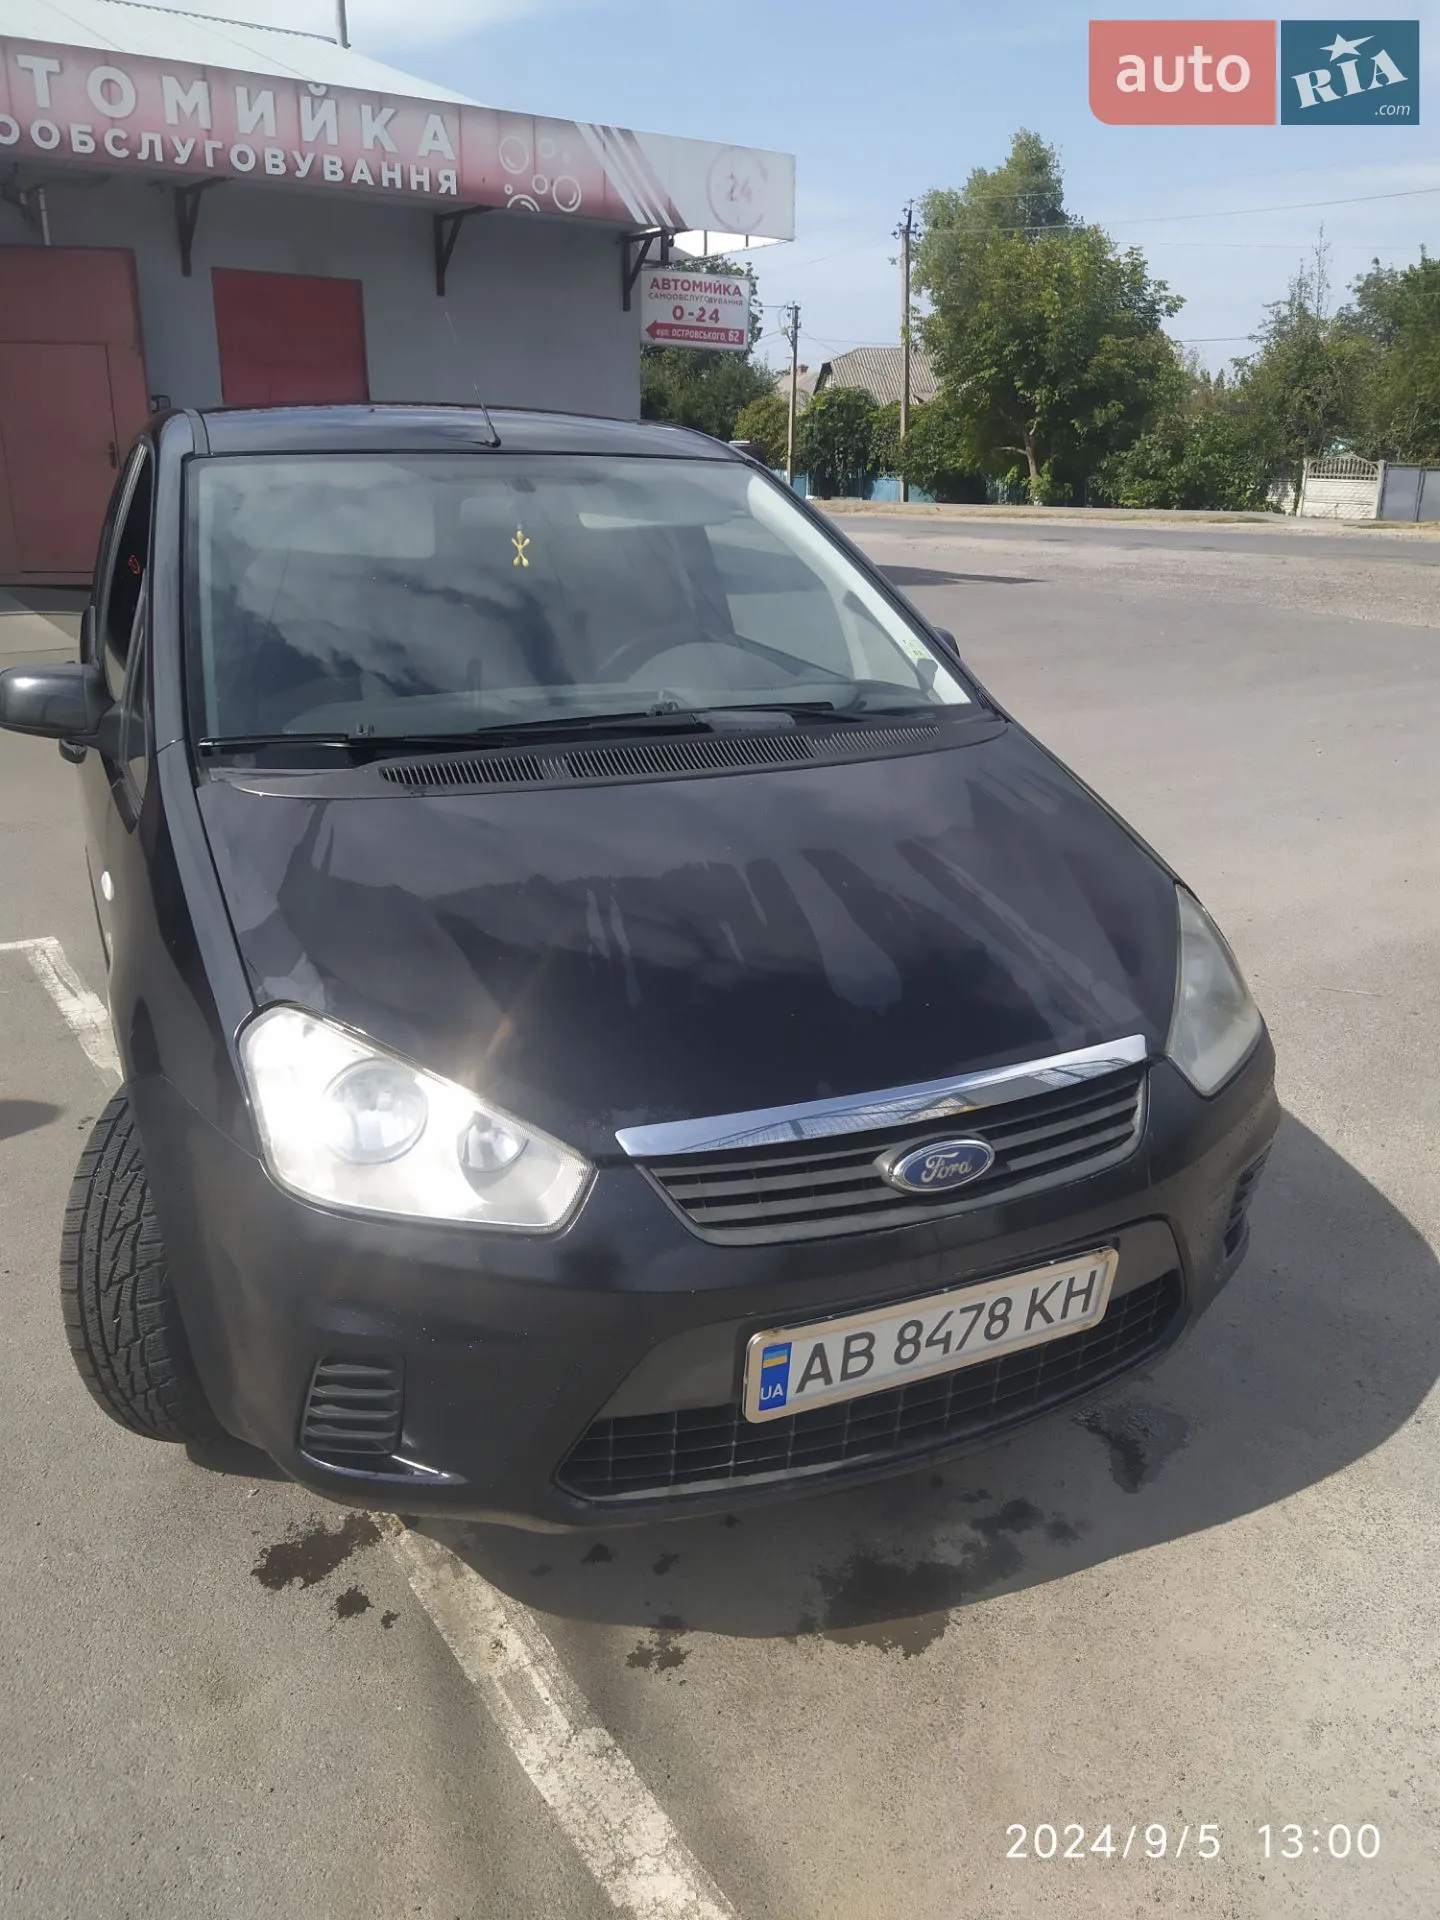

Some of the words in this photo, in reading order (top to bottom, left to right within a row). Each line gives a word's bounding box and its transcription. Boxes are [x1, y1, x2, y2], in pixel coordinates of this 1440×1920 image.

[650, 277, 742, 297] АВТОМИЙКА
[921, 1151, 973, 1183] Ford
[760, 1385, 784, 1401] UA
[795, 1332, 874, 1394] AB
[893, 1296, 1013, 1366] 8478
[1024, 1269, 1098, 1332] KH
